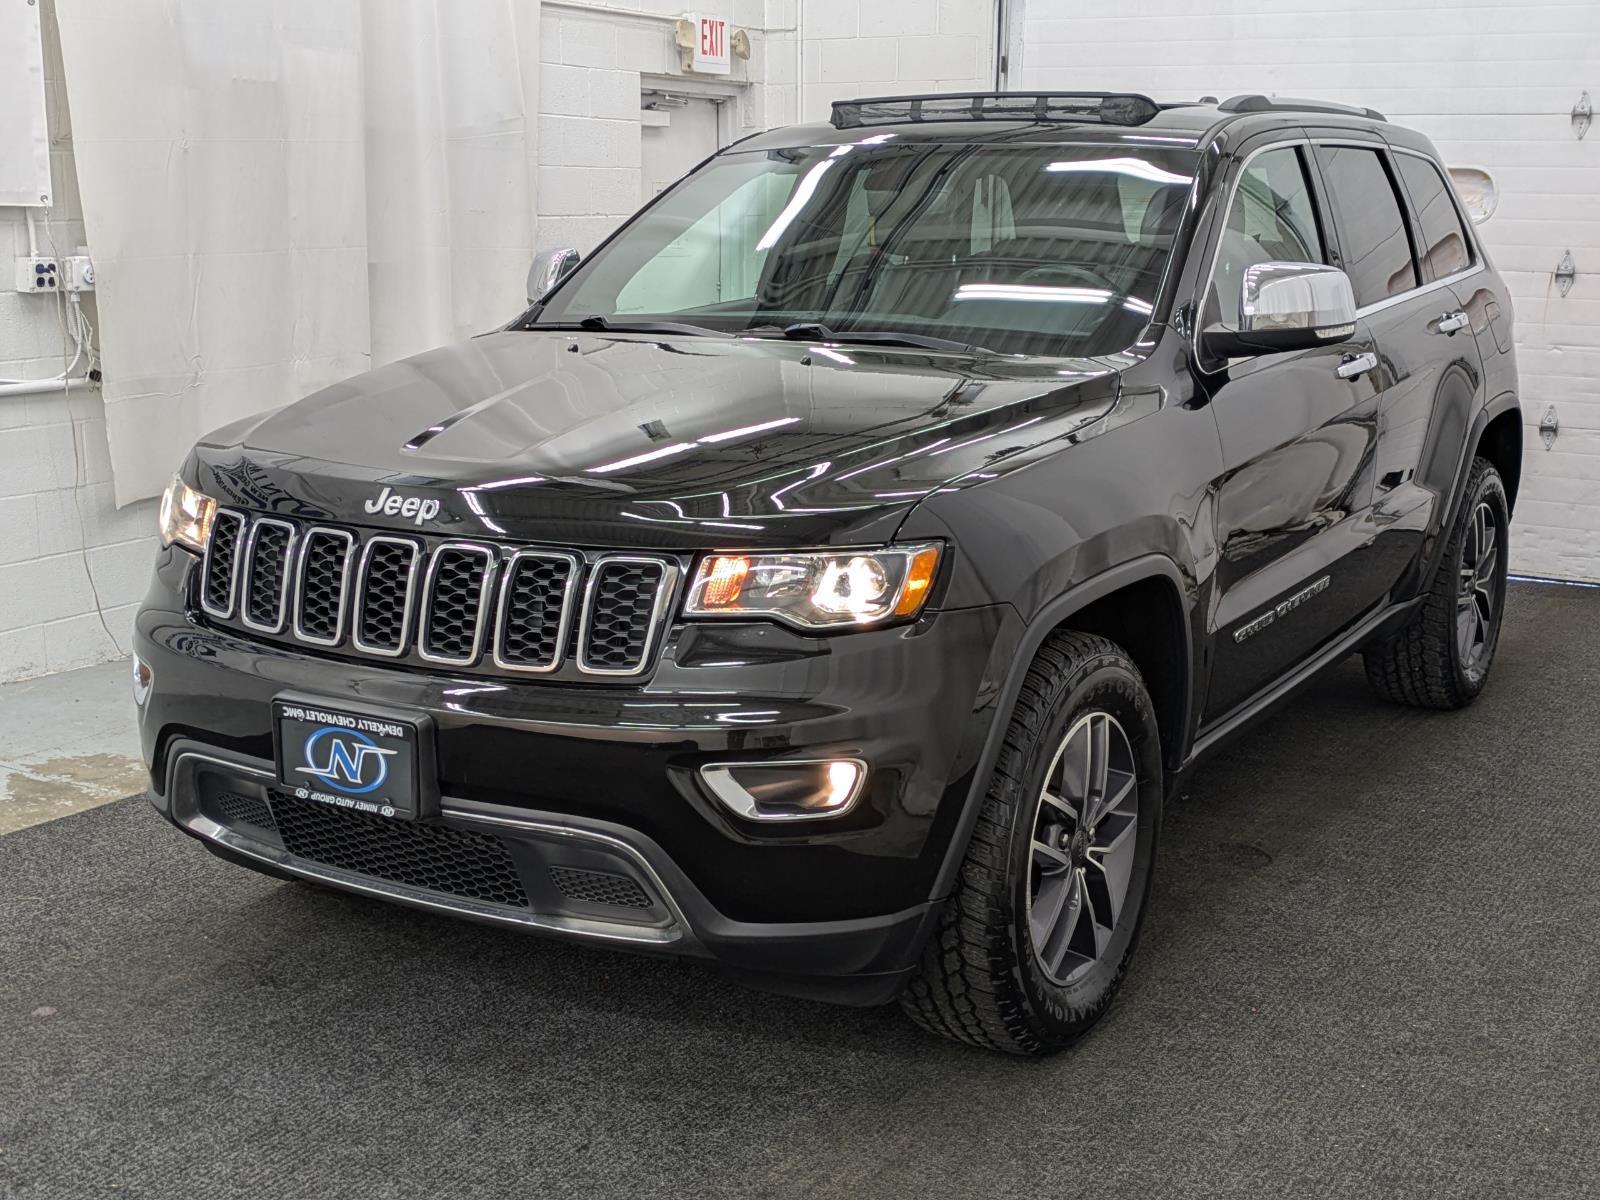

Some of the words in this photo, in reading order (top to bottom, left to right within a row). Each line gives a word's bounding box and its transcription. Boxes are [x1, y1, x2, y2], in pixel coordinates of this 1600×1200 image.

[702, 19, 724, 57] EXIT
[365, 487, 440, 526] Jeep
[282, 706, 305, 720] GMC
[306, 709, 356, 728] CHEVROLET
[311, 793, 335, 805] GROUP
[336, 797, 354, 809] AUTO
[355, 801, 378, 813] NIMEY
